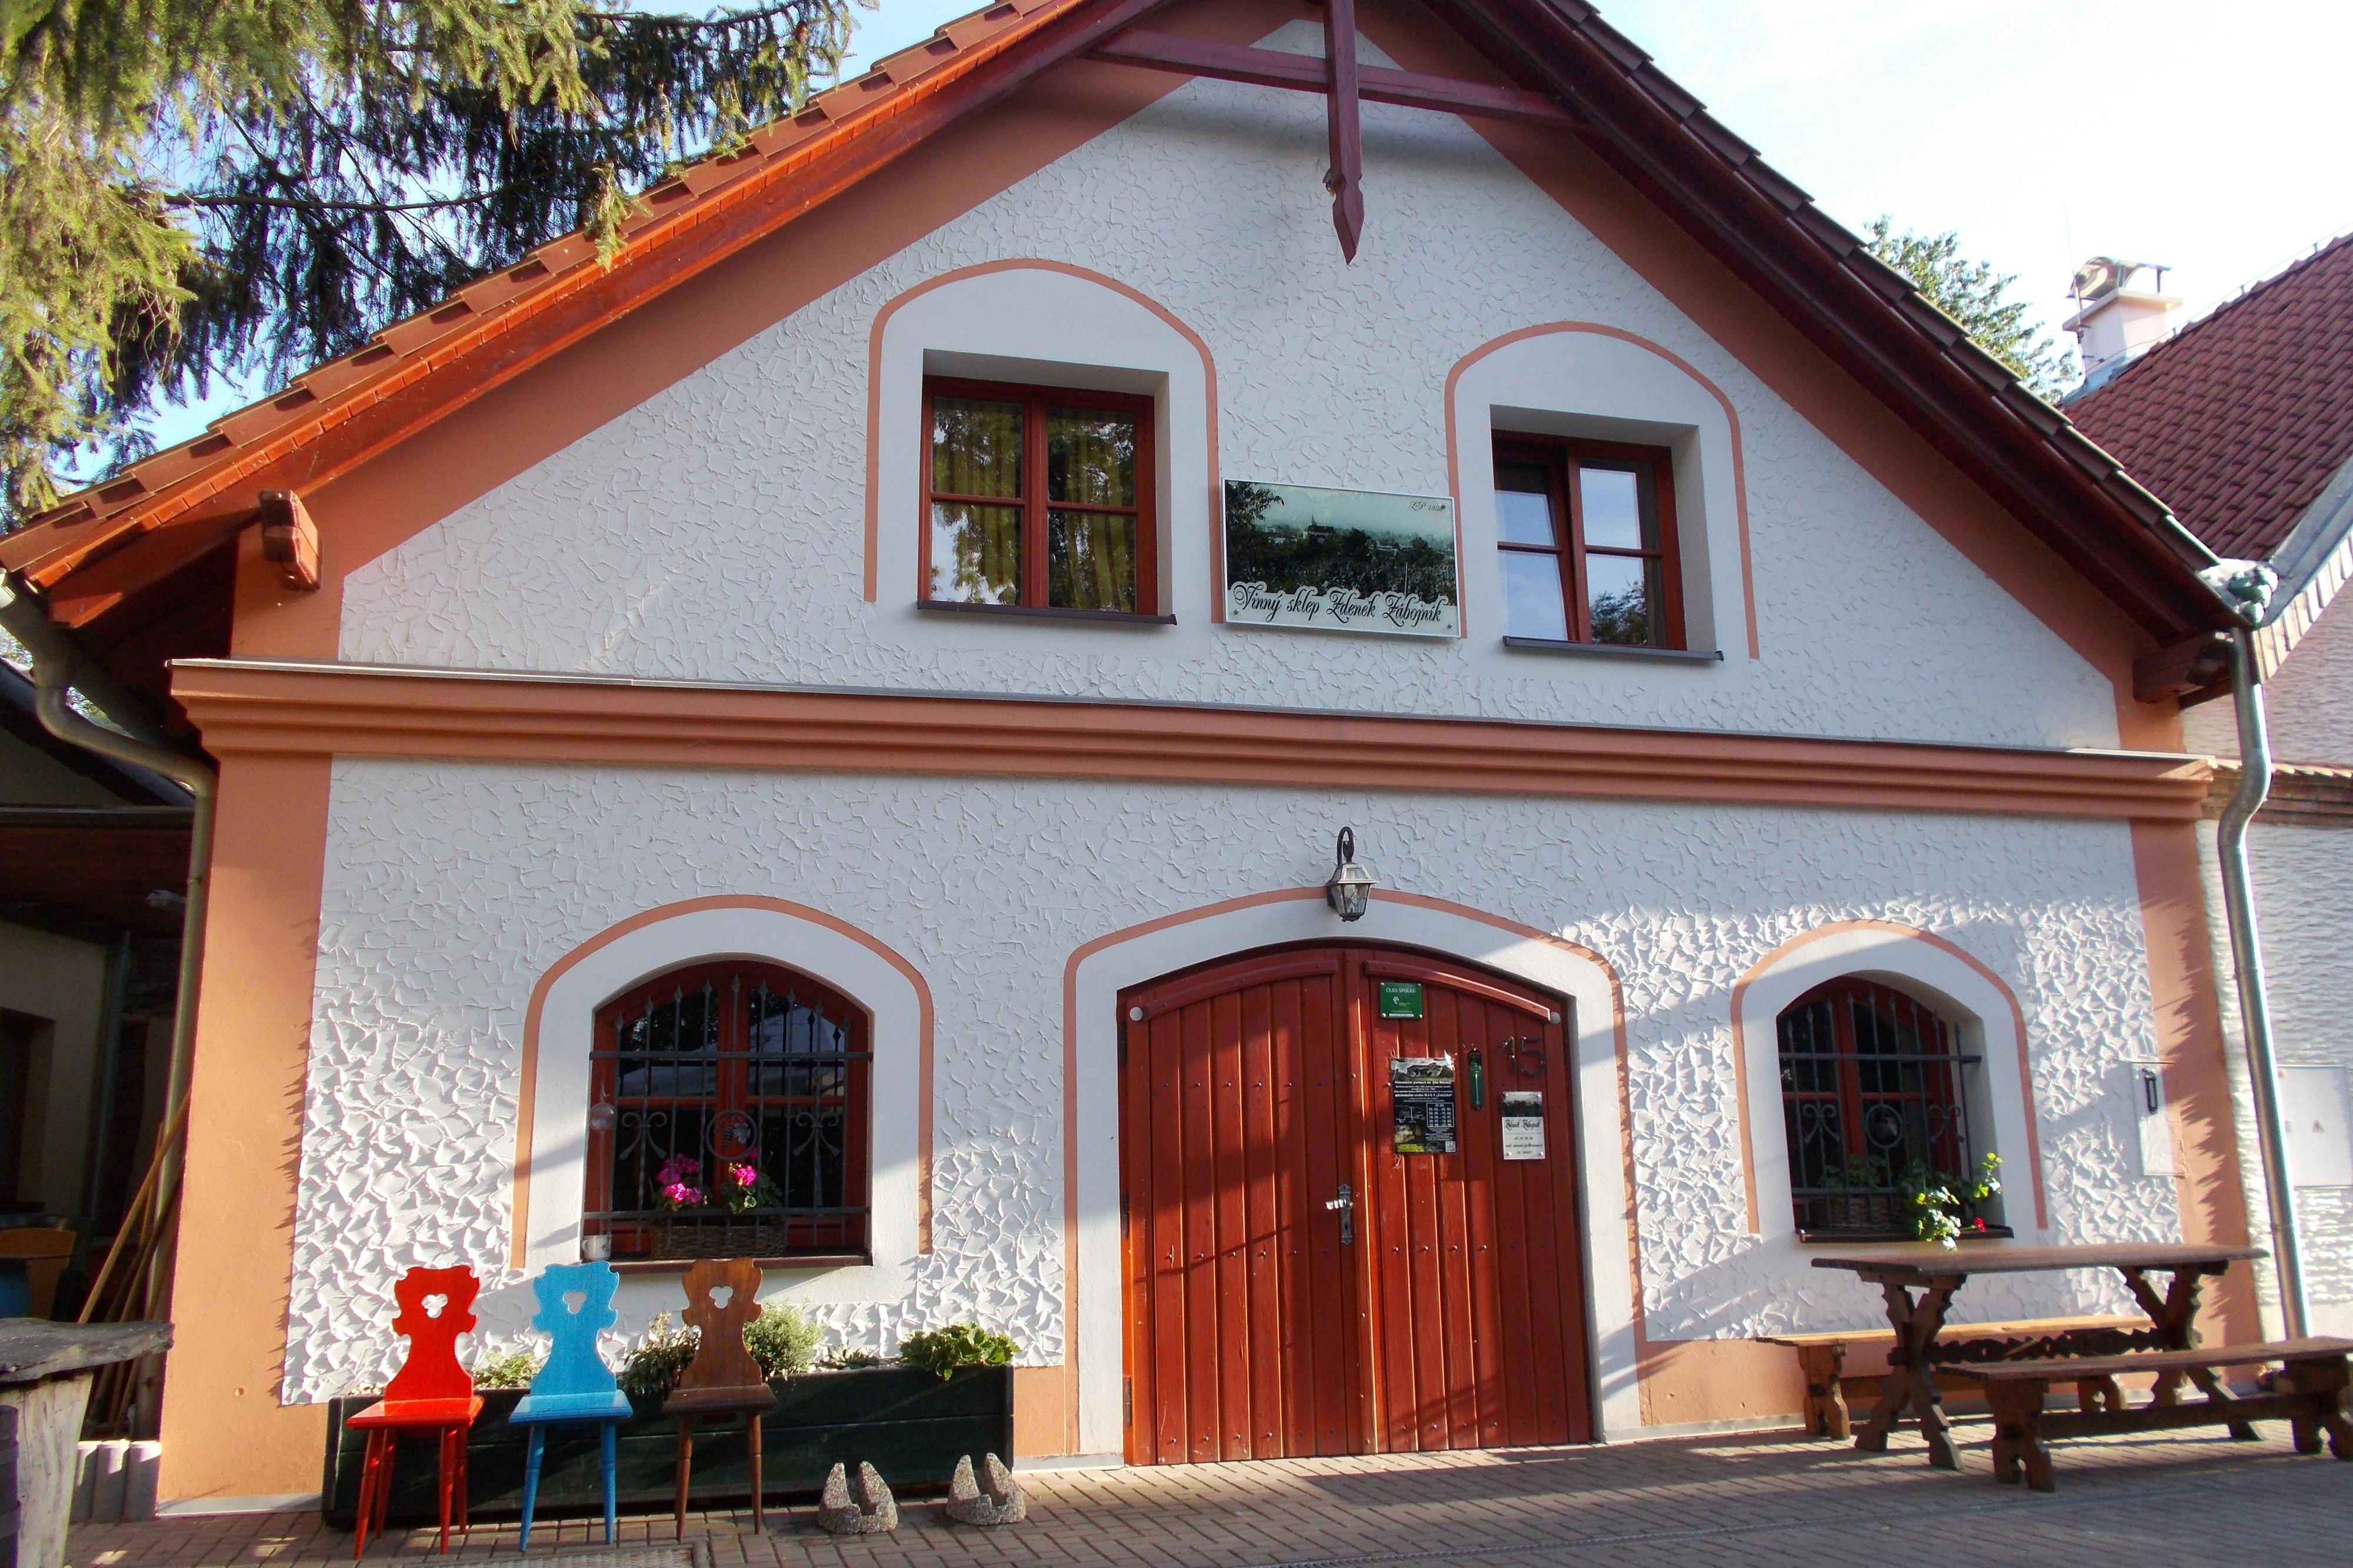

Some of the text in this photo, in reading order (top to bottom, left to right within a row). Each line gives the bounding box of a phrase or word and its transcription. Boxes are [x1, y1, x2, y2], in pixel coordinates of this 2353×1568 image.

[1233, 584, 1282, 622] Vinný
[1286, 589, 1320, 620] sklep
[1382, 594, 1446, 628] Zábojník
[1497, 1036, 1547, 1078] 15
